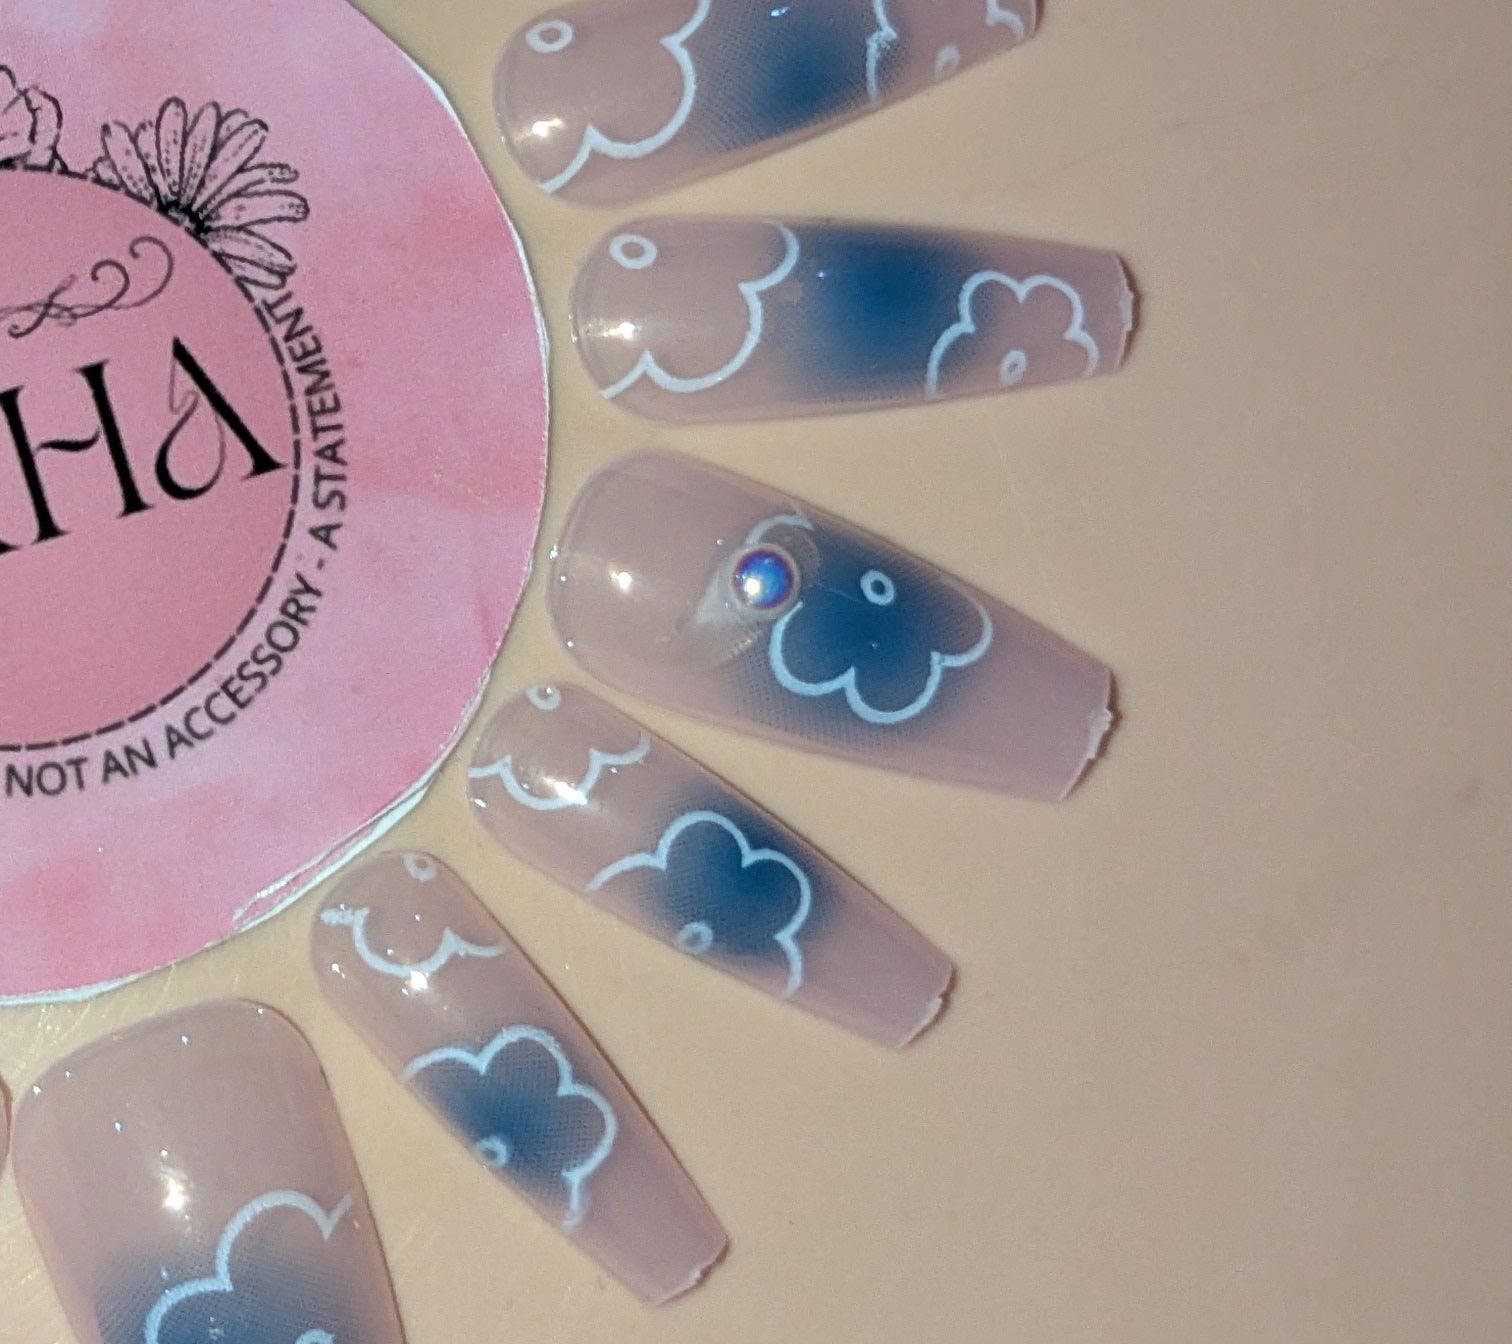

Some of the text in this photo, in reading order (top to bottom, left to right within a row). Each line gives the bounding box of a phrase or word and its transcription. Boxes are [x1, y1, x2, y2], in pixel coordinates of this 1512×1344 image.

[262, 290, 348, 511] STATEMENT
[308, 522, 343, 550] A
[165, 571, 322, 759] ACCESSORY
[5, 757, 88, 797] NOT
[101, 737, 158, 784] AN
